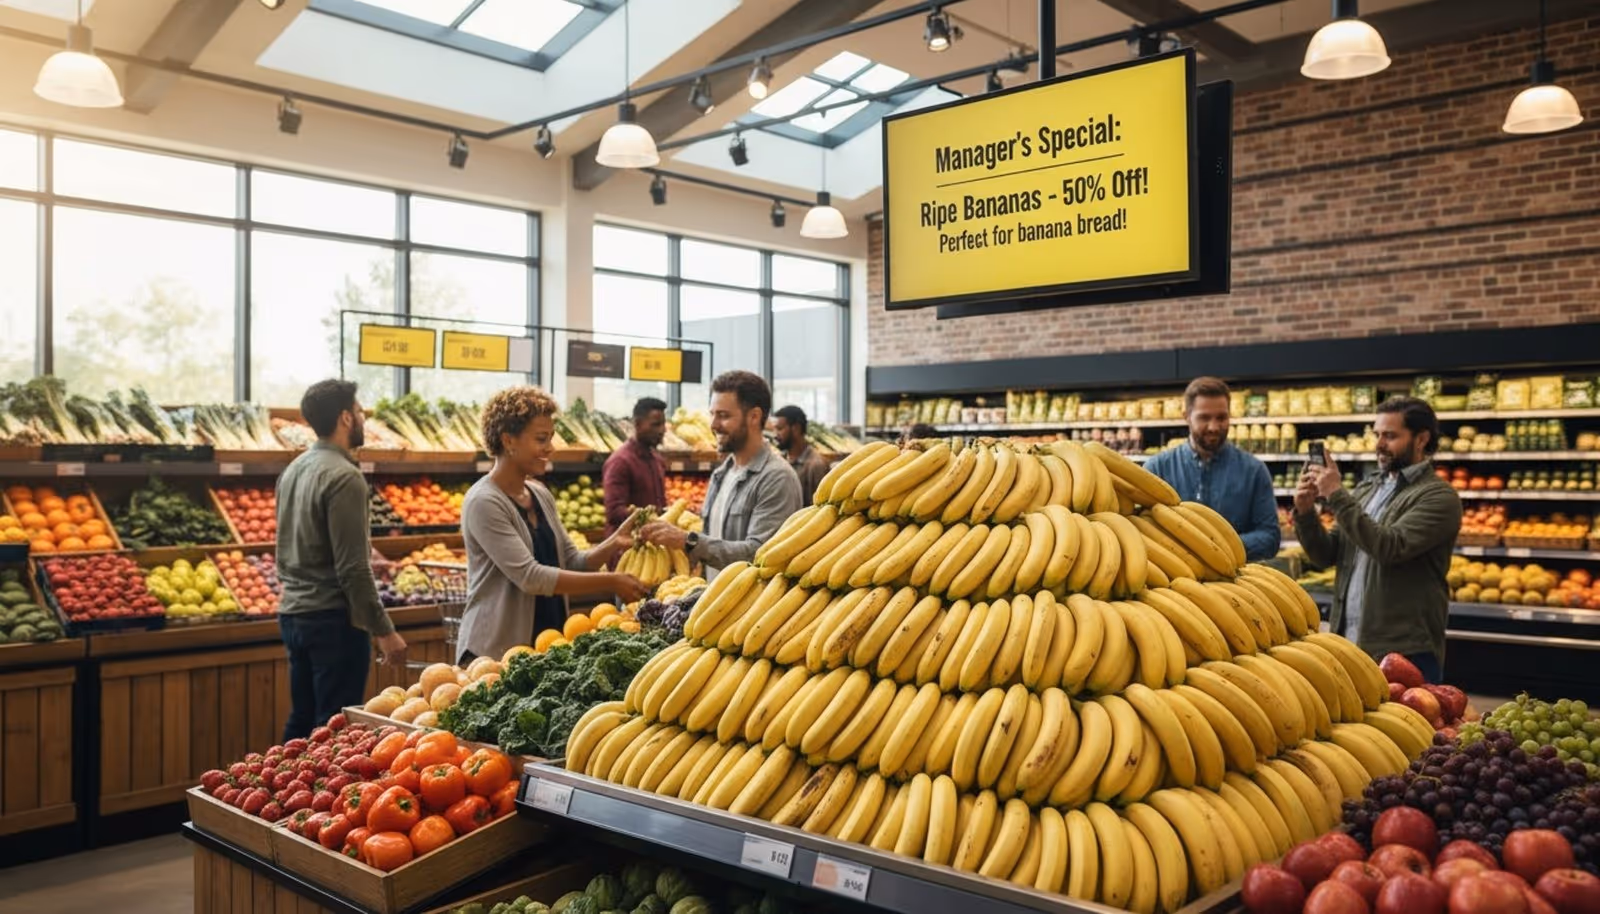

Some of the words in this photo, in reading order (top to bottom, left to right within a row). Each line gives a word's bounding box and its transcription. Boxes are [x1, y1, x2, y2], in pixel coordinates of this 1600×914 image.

[935, 131, 1032, 174] Manager's
[1039, 113, 1121, 158] Special:
[920, 200, 958, 232] Ripe
[963, 189, 1042, 221] Bananas
[1062, 173, 1106, 206] 50%
[1112, 166, 1149, 199] Off!
[939, 229, 989, 254] Perfect
[992, 224, 1014, 246] for
[1017, 220, 1073, 243] banana
[1077, 207, 1127, 235] bread!
